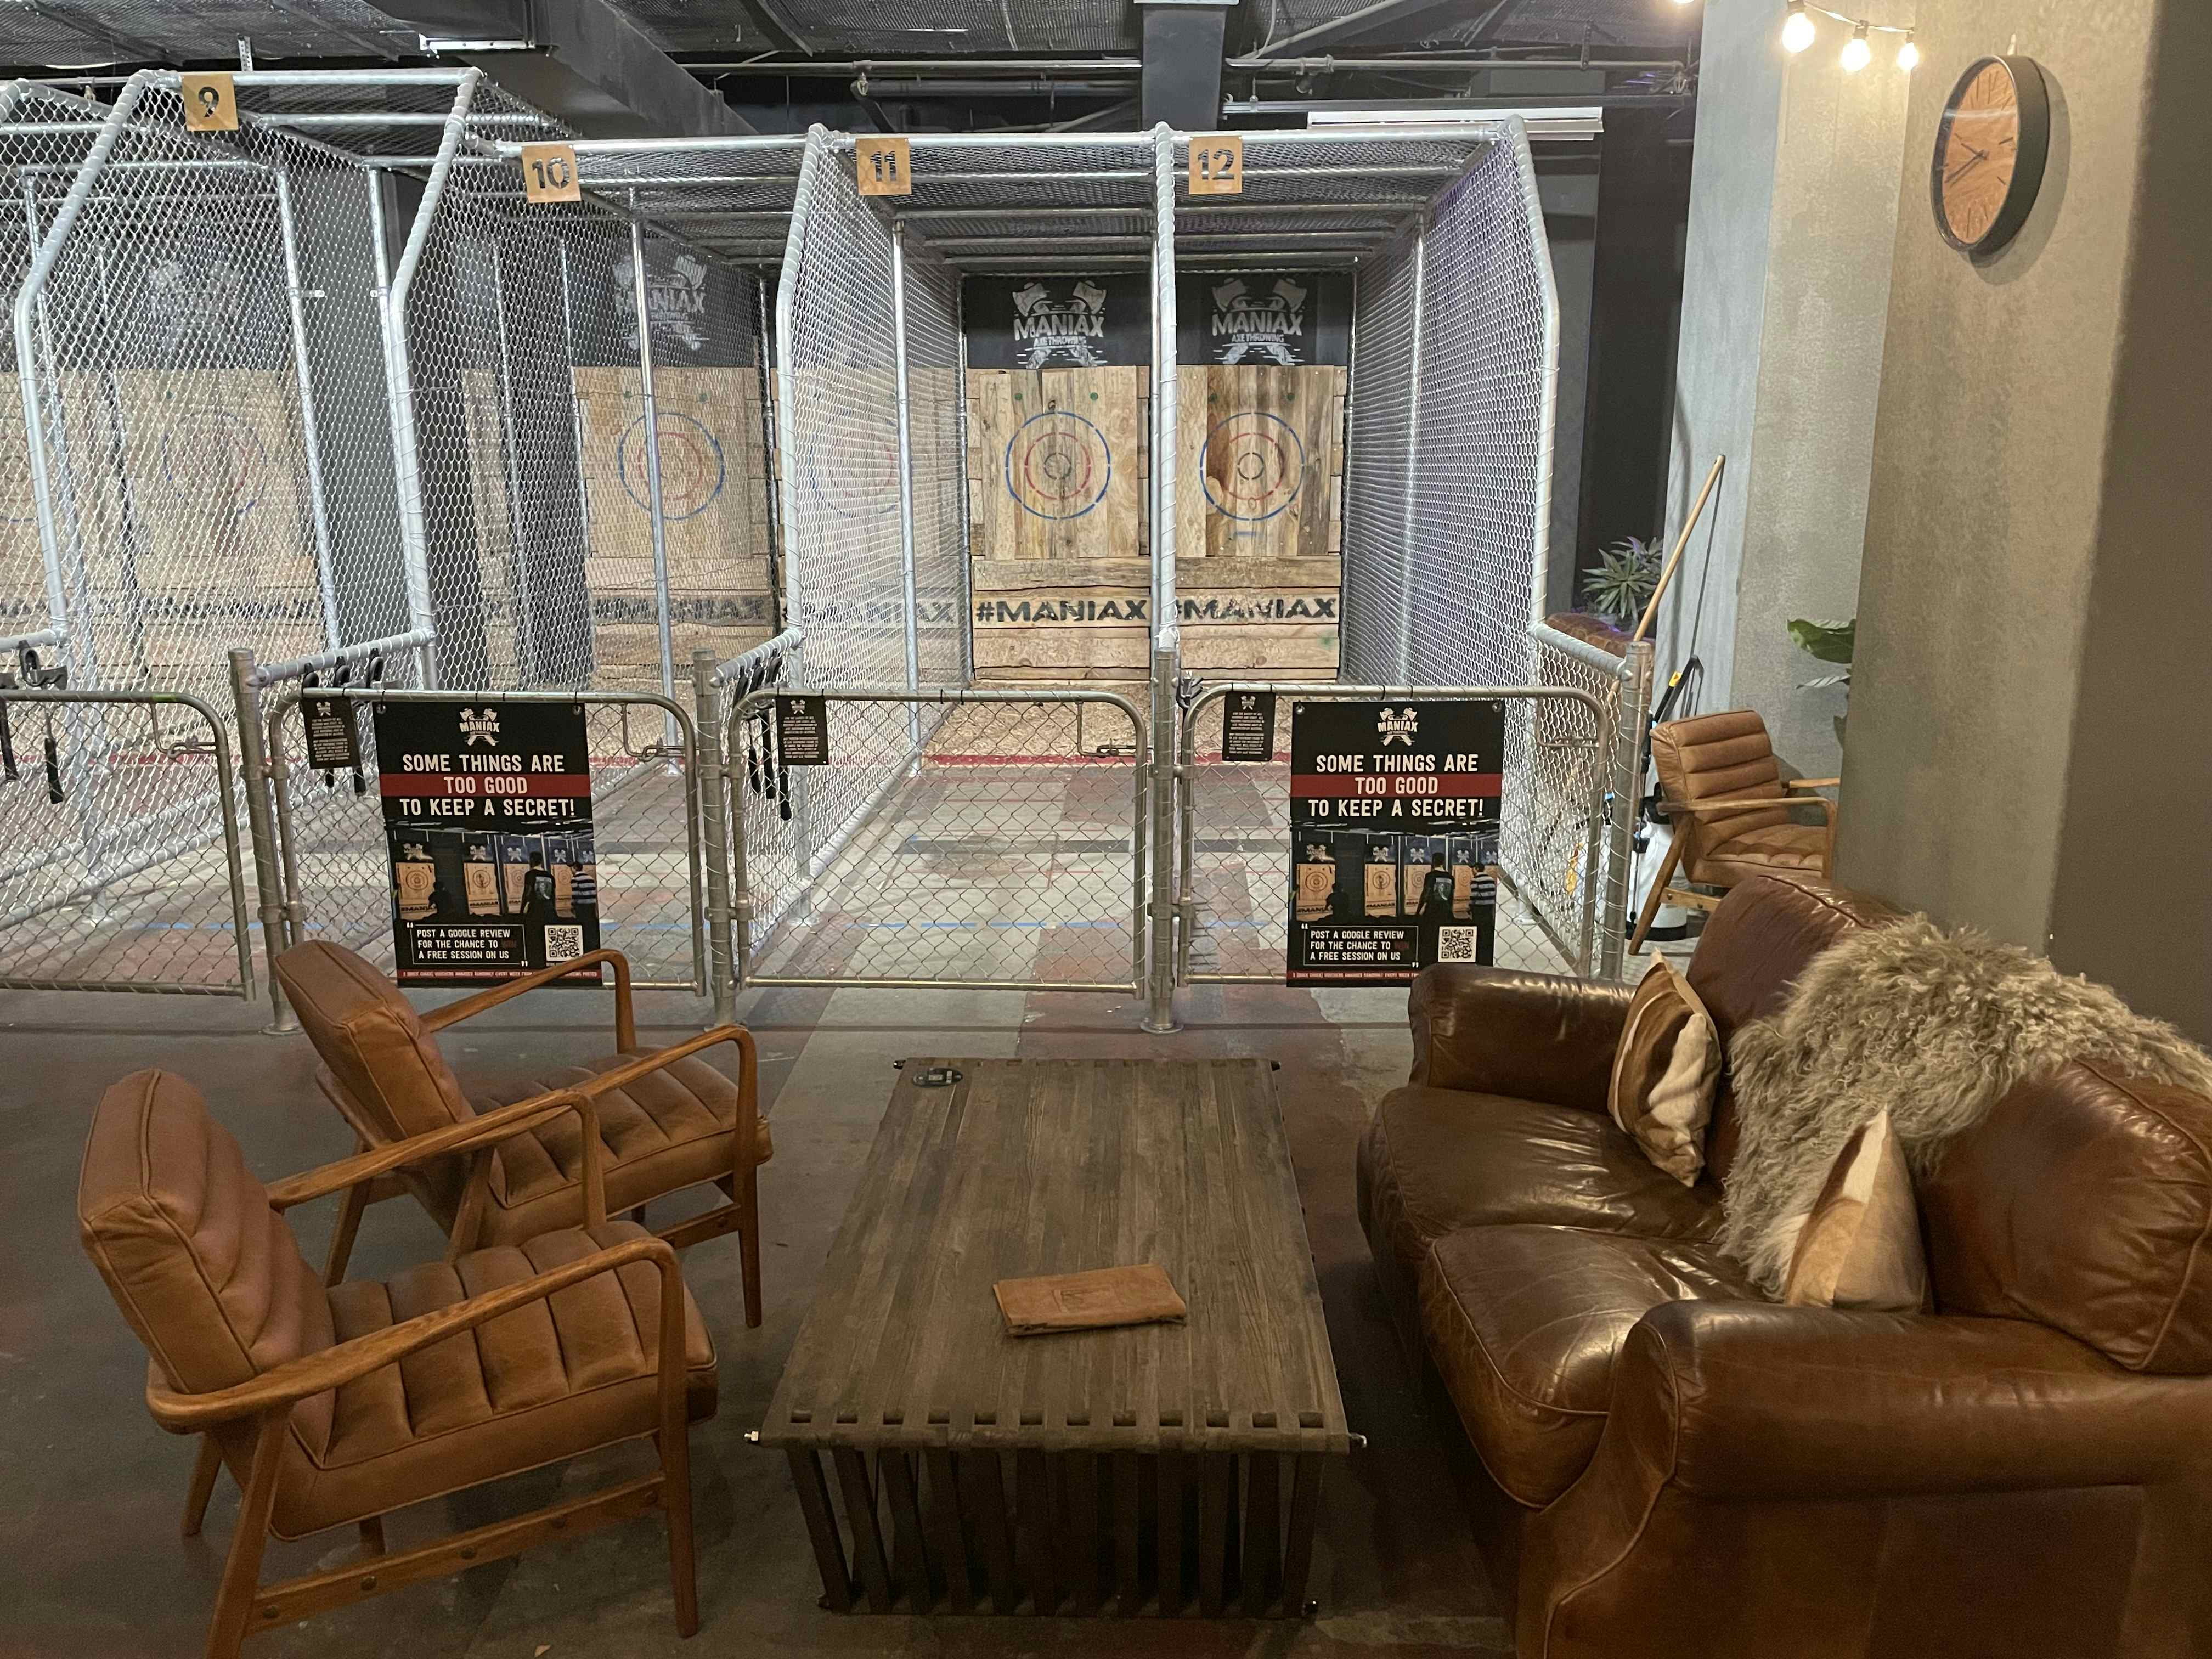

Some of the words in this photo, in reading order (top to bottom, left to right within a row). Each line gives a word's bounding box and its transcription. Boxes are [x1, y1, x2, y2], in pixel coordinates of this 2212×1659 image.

[198, 86, 219, 118] 9
[531, 157, 571, 189] 10
[870, 149, 898, 183] 11
[1197, 148, 1235, 180] 12
[1013, 313, 1105, 340] MANIAX
[1211, 313, 1304, 337] MANIAX
[976, 600, 1147, 623] #MANIAX
[460, 721, 500, 732] MANIAX
[1378, 721, 1418, 732] MANIAX
[403, 754, 450, 771] SOME
[459, 754, 522, 772] THINGS
[532, 755, 565, 772] ARE
[1316, 754, 1364, 772] SOME
[1373, 754, 1436, 772] THINGS
[1444, 754, 1479, 771] ARE
[444, 776, 476, 794] TOO
[484, 776, 527, 794] GOOD
[1355, 776, 1387, 794] TOO
[1395, 776, 1438, 794] GOOD
[399, 798, 421, 815] TO
[430, 799, 475, 816] KEEP
[484, 799, 495, 816] A
[504, 799, 574, 816] SECRET!
[1308, 799, 1329, 817] TO
[1338, 799, 1383, 816] KEEP
[1391, 799, 1402, 816] A
[1412, 799, 1483, 816] SECRET!
[417, 929, 436, 938] POST
[448, 929, 477, 938] GOOGLE
[480, 929, 510, 938] REVIEW
[1311, 930, 1330, 939] POST
[1333, 930, 1339, 939] A
[1341, 930, 1370, 939] GOOGLE
[1373, 930, 1404, 939] REVIEW
[418, 940, 432, 948] FOR
[436, 940, 451, 948] THE
[454, 940, 485, 948] CHANCE
[488, 940, 498, 948] TO
[1310, 941, 1325, 950] FOR
[1328, 941, 1344, 950] THE
[1346, 941, 1378, 950] CHANCE
[1381, 941, 1391, 950] TO
[419, 951, 424, 959] A
[427, 951, 447, 959] FREE
[450, 951, 482, 959] SESSION
[486, 951, 496, 959] ON
[499, 951, 509, 959] US
[1310, 952, 1316, 960] A
[1319, 952, 1339, 960] FREE
[1342, 952, 1374, 960] SESSION
[1377, 952, 1387, 960] ON
[1390, 952, 1401, 960] US
